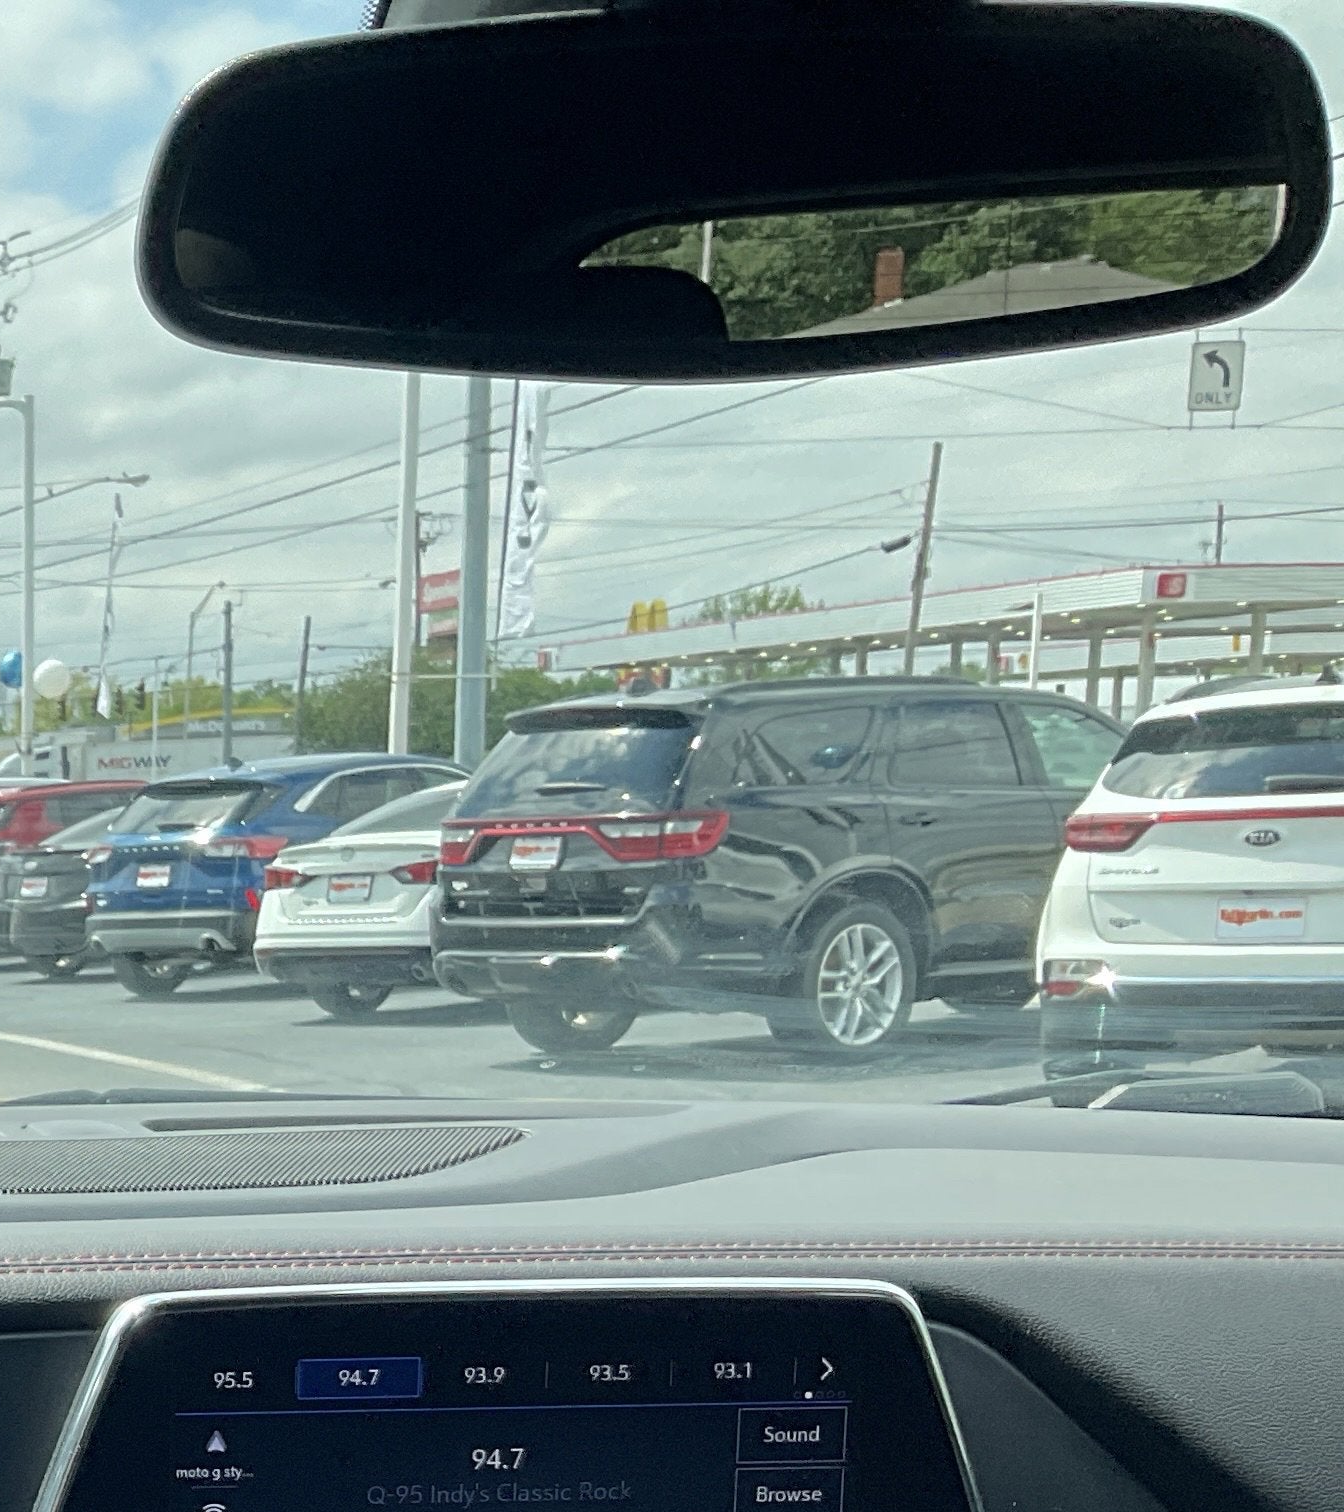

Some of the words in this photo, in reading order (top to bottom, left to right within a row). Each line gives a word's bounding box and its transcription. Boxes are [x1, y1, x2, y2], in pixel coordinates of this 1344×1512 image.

[1195, 392, 1232, 405] ONLY
[1248, 831, 1276, 844] KIA
[338, 1368, 380, 1386] 94.7
[464, 1366, 506, 1384] 93.9
[589, 1364, 631, 1382] 93.5
[713, 1361, 752, 1379] 93.1
[213, 1371, 253, 1389] 95.5
[763, 1425, 821, 1443] Sound
[472, 1447, 525, 1470] 94.7
[175, 1467, 210, 1479] moto
[211, 1468, 221, 1481] g
[366, 1484, 423, 1505] Q-95
[430, 1482, 490, 1509] Indy's
[496, 1482, 572, 1502] Classic
[579, 1480, 631, 1501] Rock
[755, 1485, 823, 1503] Browse
